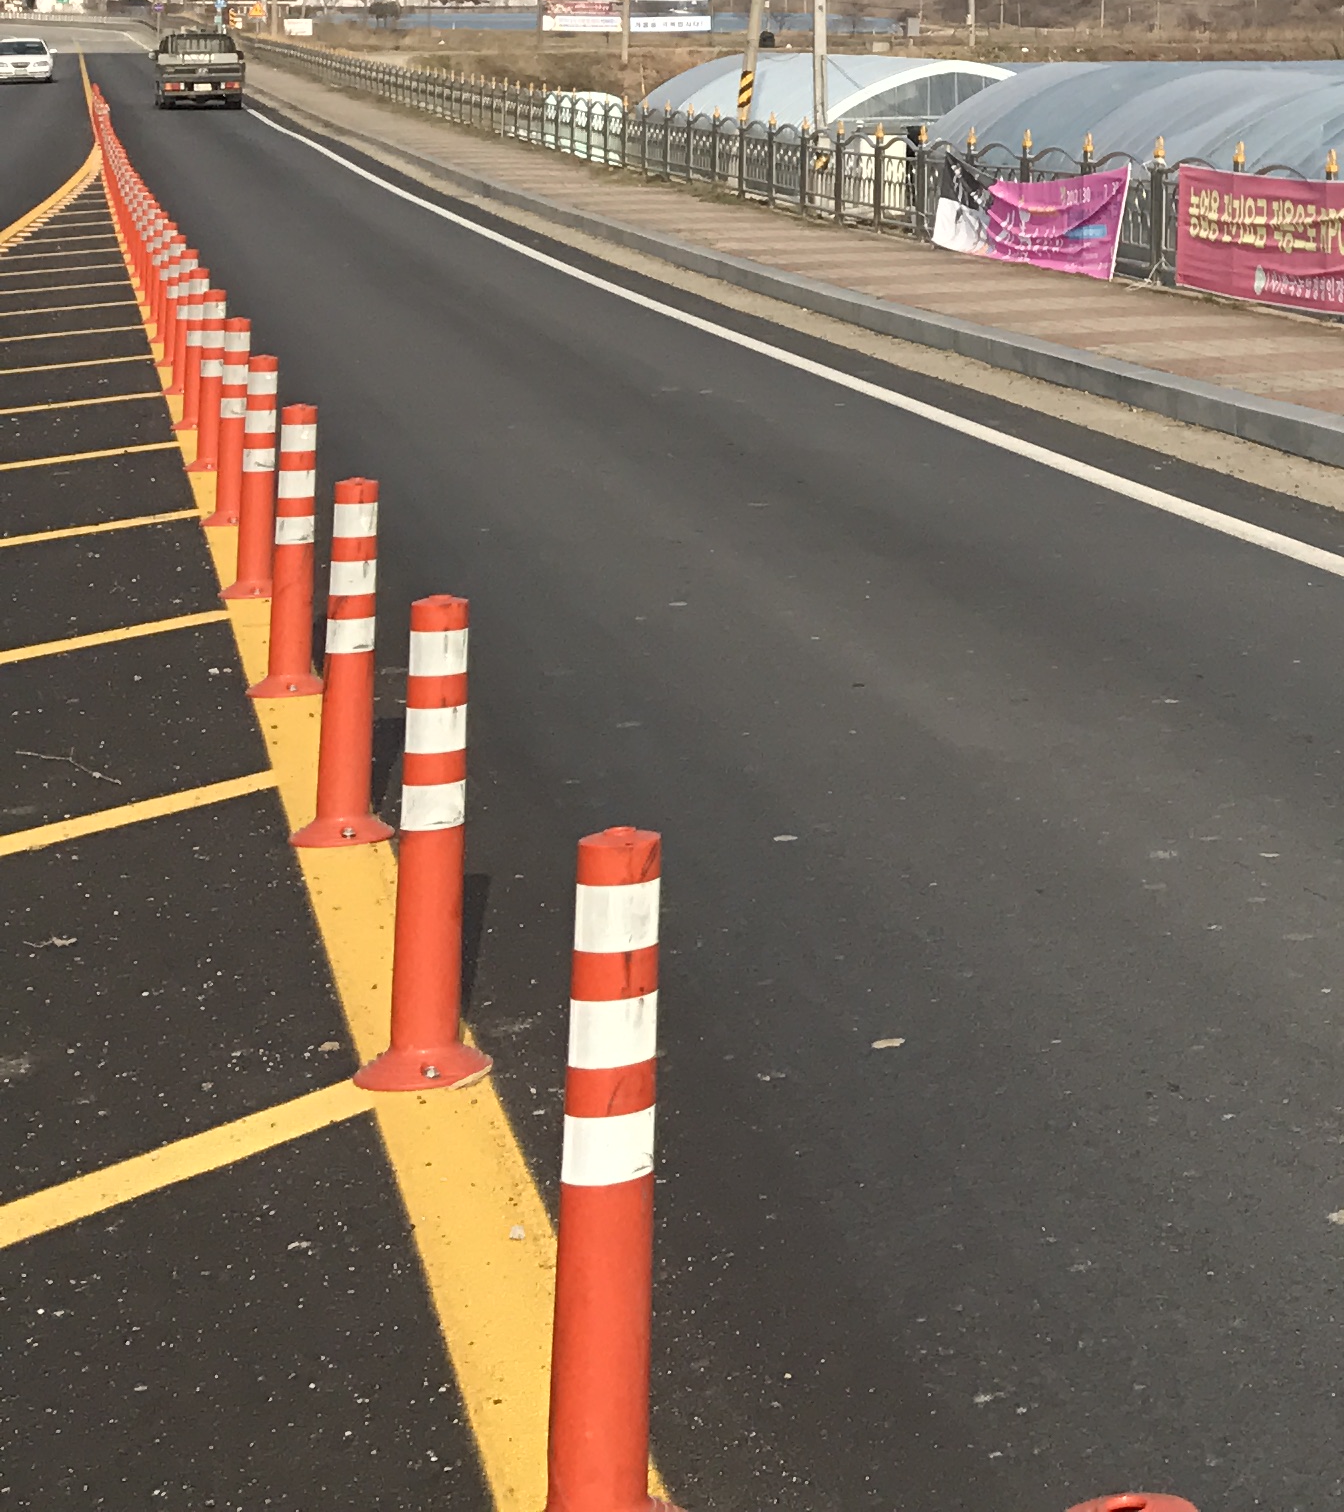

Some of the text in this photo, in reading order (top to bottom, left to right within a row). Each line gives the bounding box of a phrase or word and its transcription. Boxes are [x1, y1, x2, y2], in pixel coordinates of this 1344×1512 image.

[1189, 186, 1220, 241] 농업용
[1221, 193, 1268, 249] 전기요금
[1269, 196, 1318, 254] 적용으로
